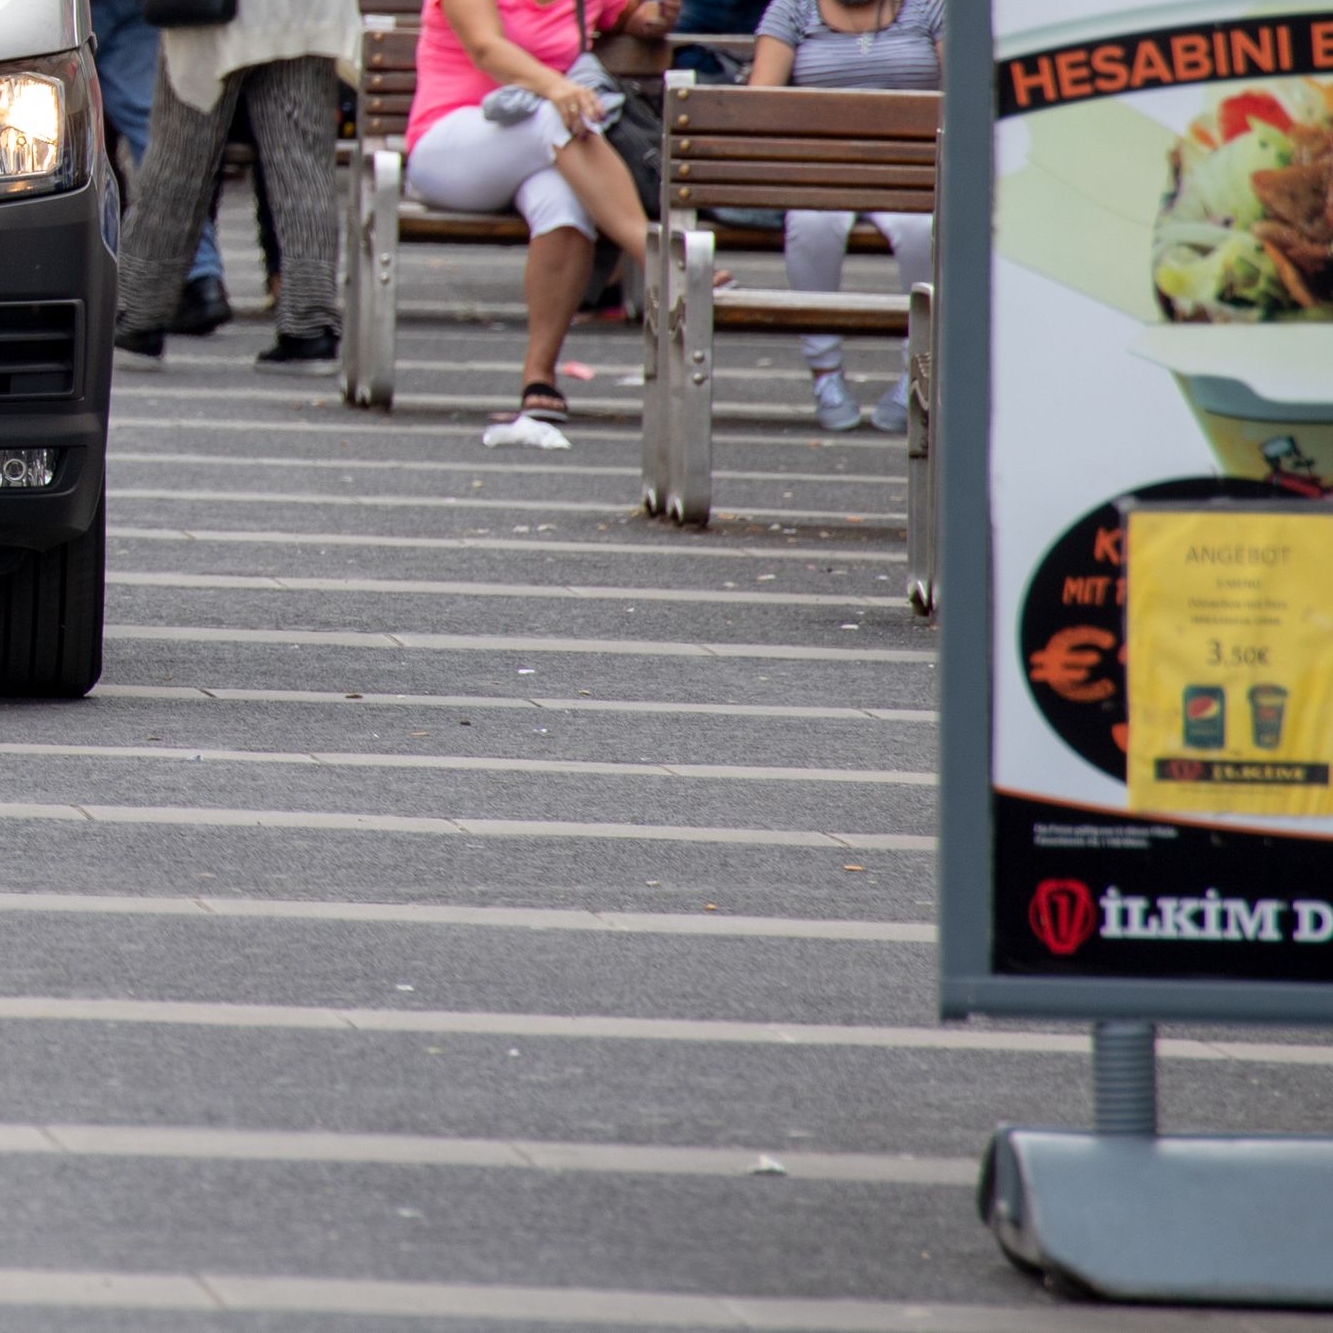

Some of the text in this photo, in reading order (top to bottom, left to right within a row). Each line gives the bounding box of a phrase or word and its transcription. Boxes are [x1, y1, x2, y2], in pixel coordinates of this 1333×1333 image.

[1010, 24, 1294, 107] HESABINI
[1184, 544, 1292, 565] ANGEBOT
[1061, 576, 1111, 606] MIT
[1099, 884, 1284, 942] İLKİM
